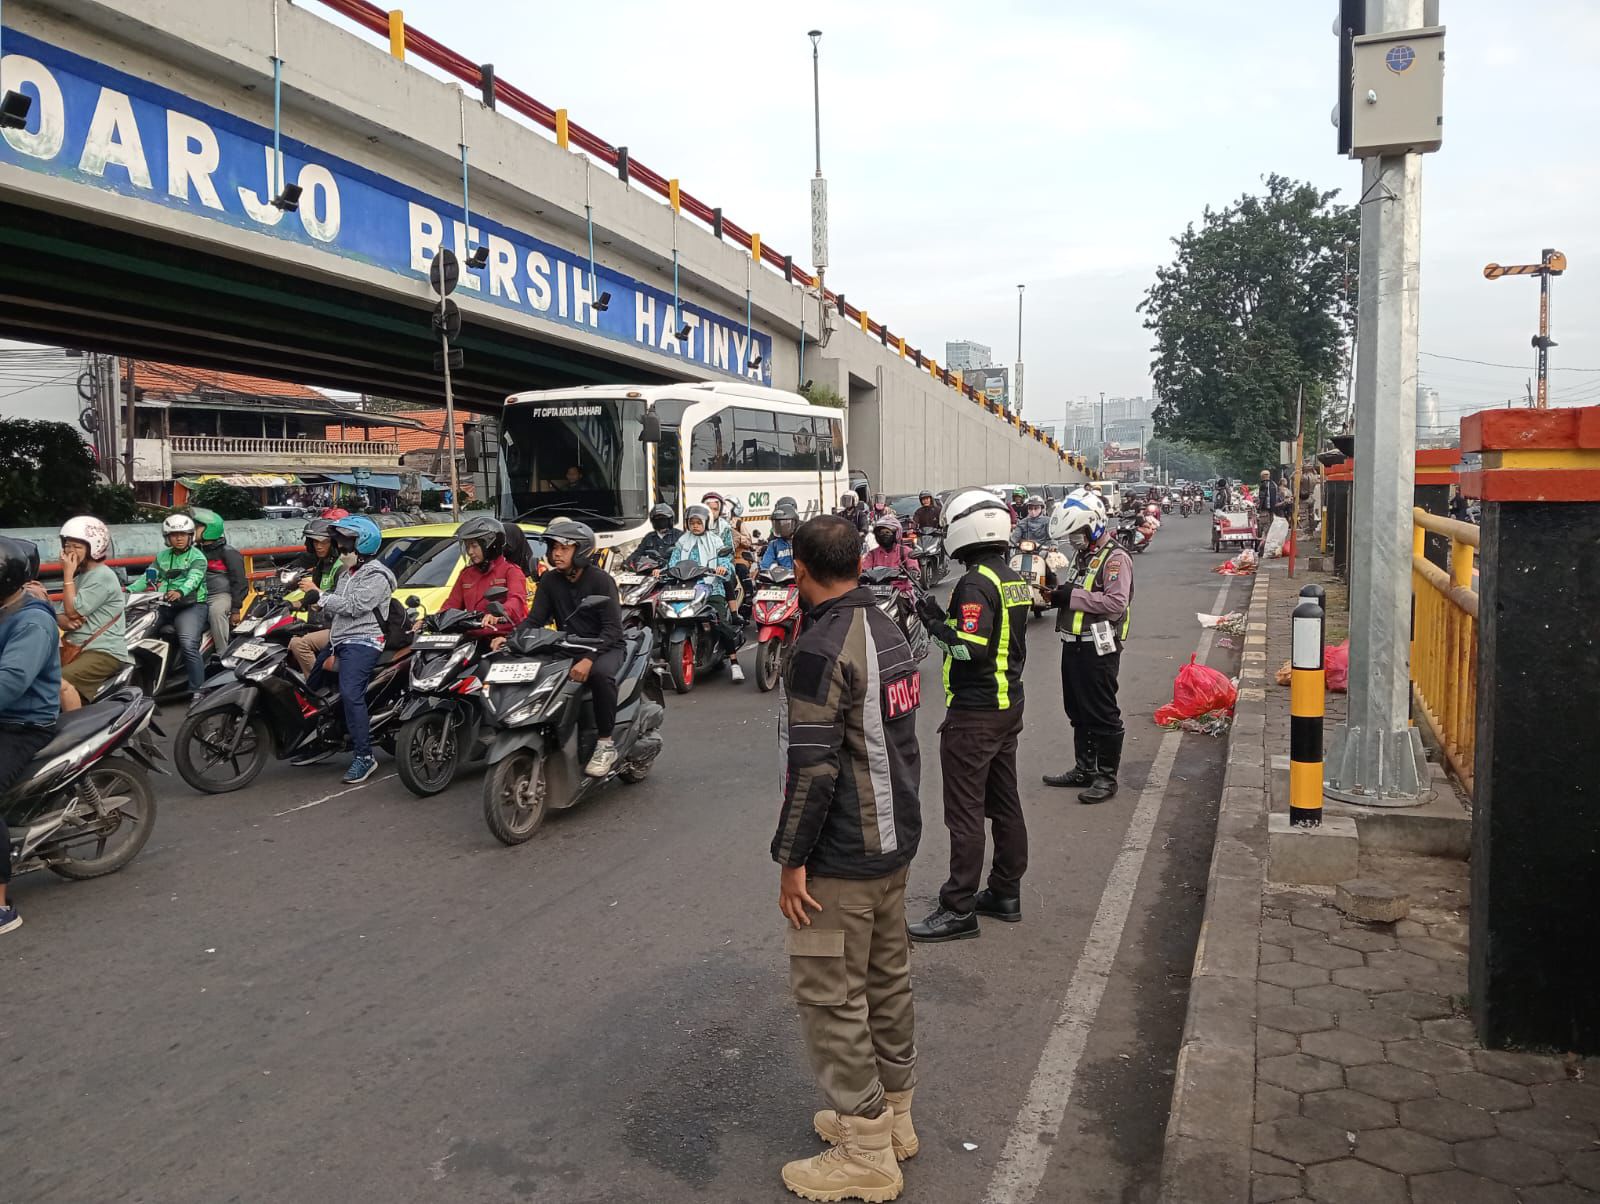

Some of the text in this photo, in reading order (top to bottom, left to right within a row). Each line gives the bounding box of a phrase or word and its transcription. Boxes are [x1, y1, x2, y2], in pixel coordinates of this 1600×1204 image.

[0, 54, 763, 381] OARJO BERSIH HATINYA
[533, 405, 602, 418] PT CIPTA KRIDA BAHARI
